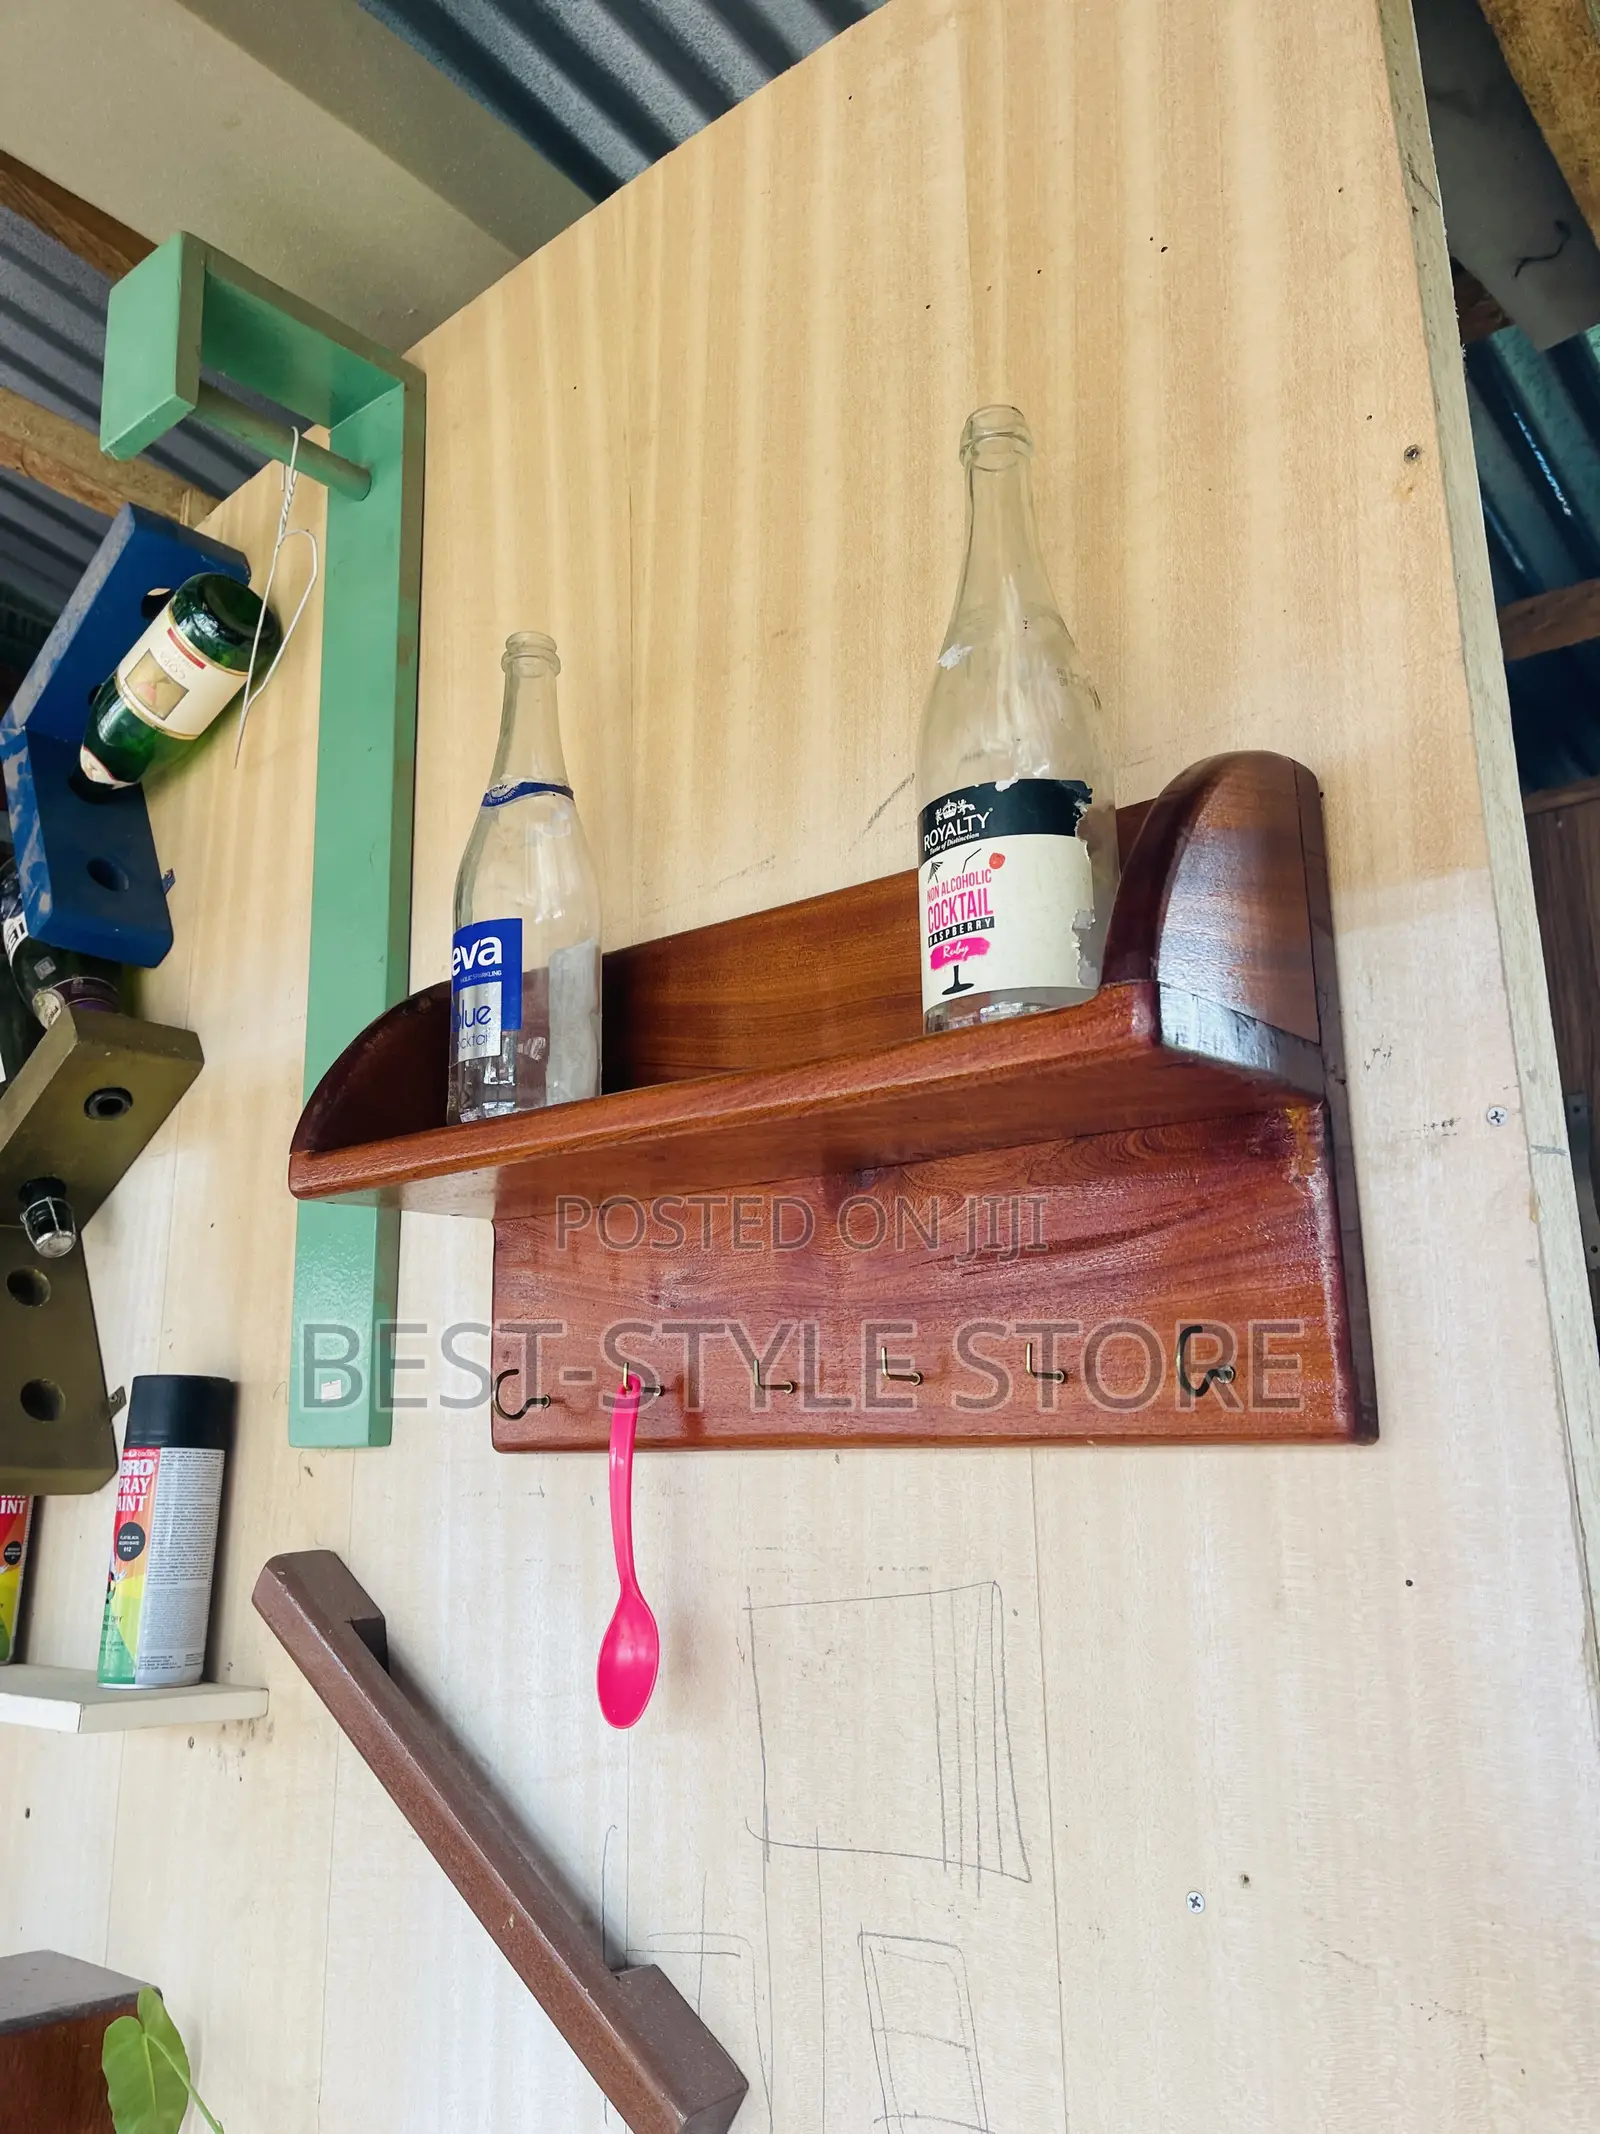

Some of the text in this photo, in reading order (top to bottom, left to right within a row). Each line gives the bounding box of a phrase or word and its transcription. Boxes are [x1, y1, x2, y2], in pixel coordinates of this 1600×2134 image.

[924, 811, 989, 851] ROYALTY
[927, 868, 992, 903] NON ALCOHOLIC
[927, 887, 994, 934] COCKTAIL
[929, 917, 992, 946] RASPBERRY
[943, 941, 970, 959] Ruby
[452, 936, 503, 977] eva
